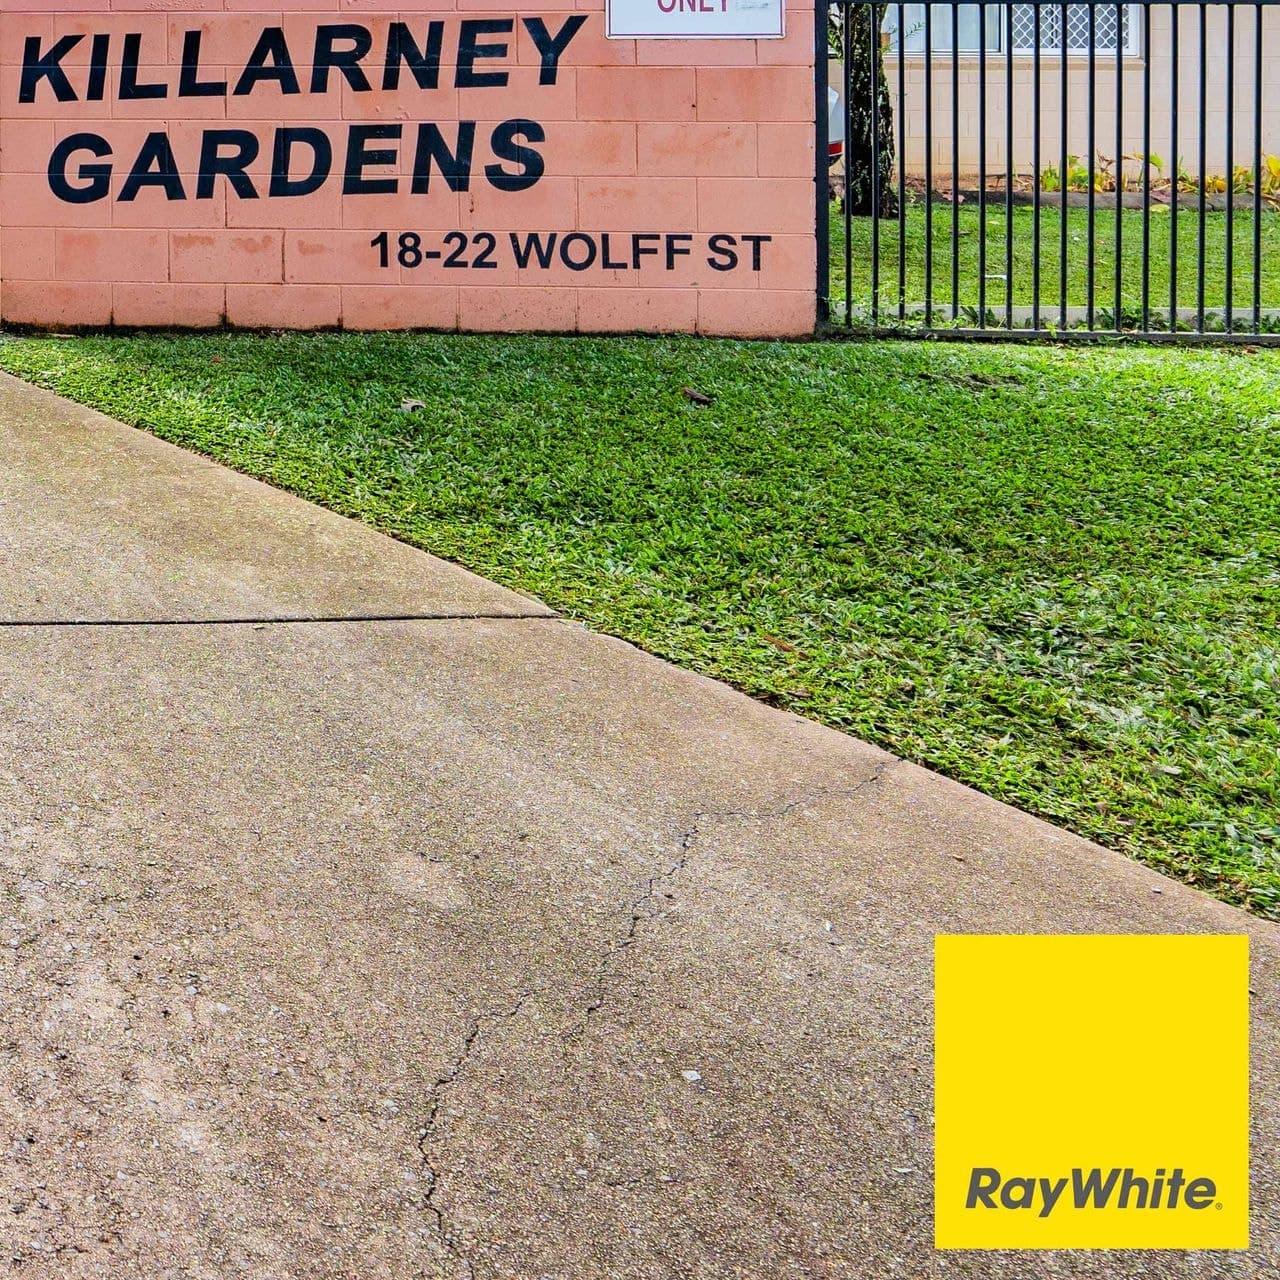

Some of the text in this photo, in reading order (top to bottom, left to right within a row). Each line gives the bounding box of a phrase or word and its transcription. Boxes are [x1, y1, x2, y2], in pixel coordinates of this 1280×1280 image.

[18, 15, 588, 103] KILLARNEY
[47, 119, 545, 204] GARDENS
[370, 231, 772, 272] 18-22 WOLFF ST
